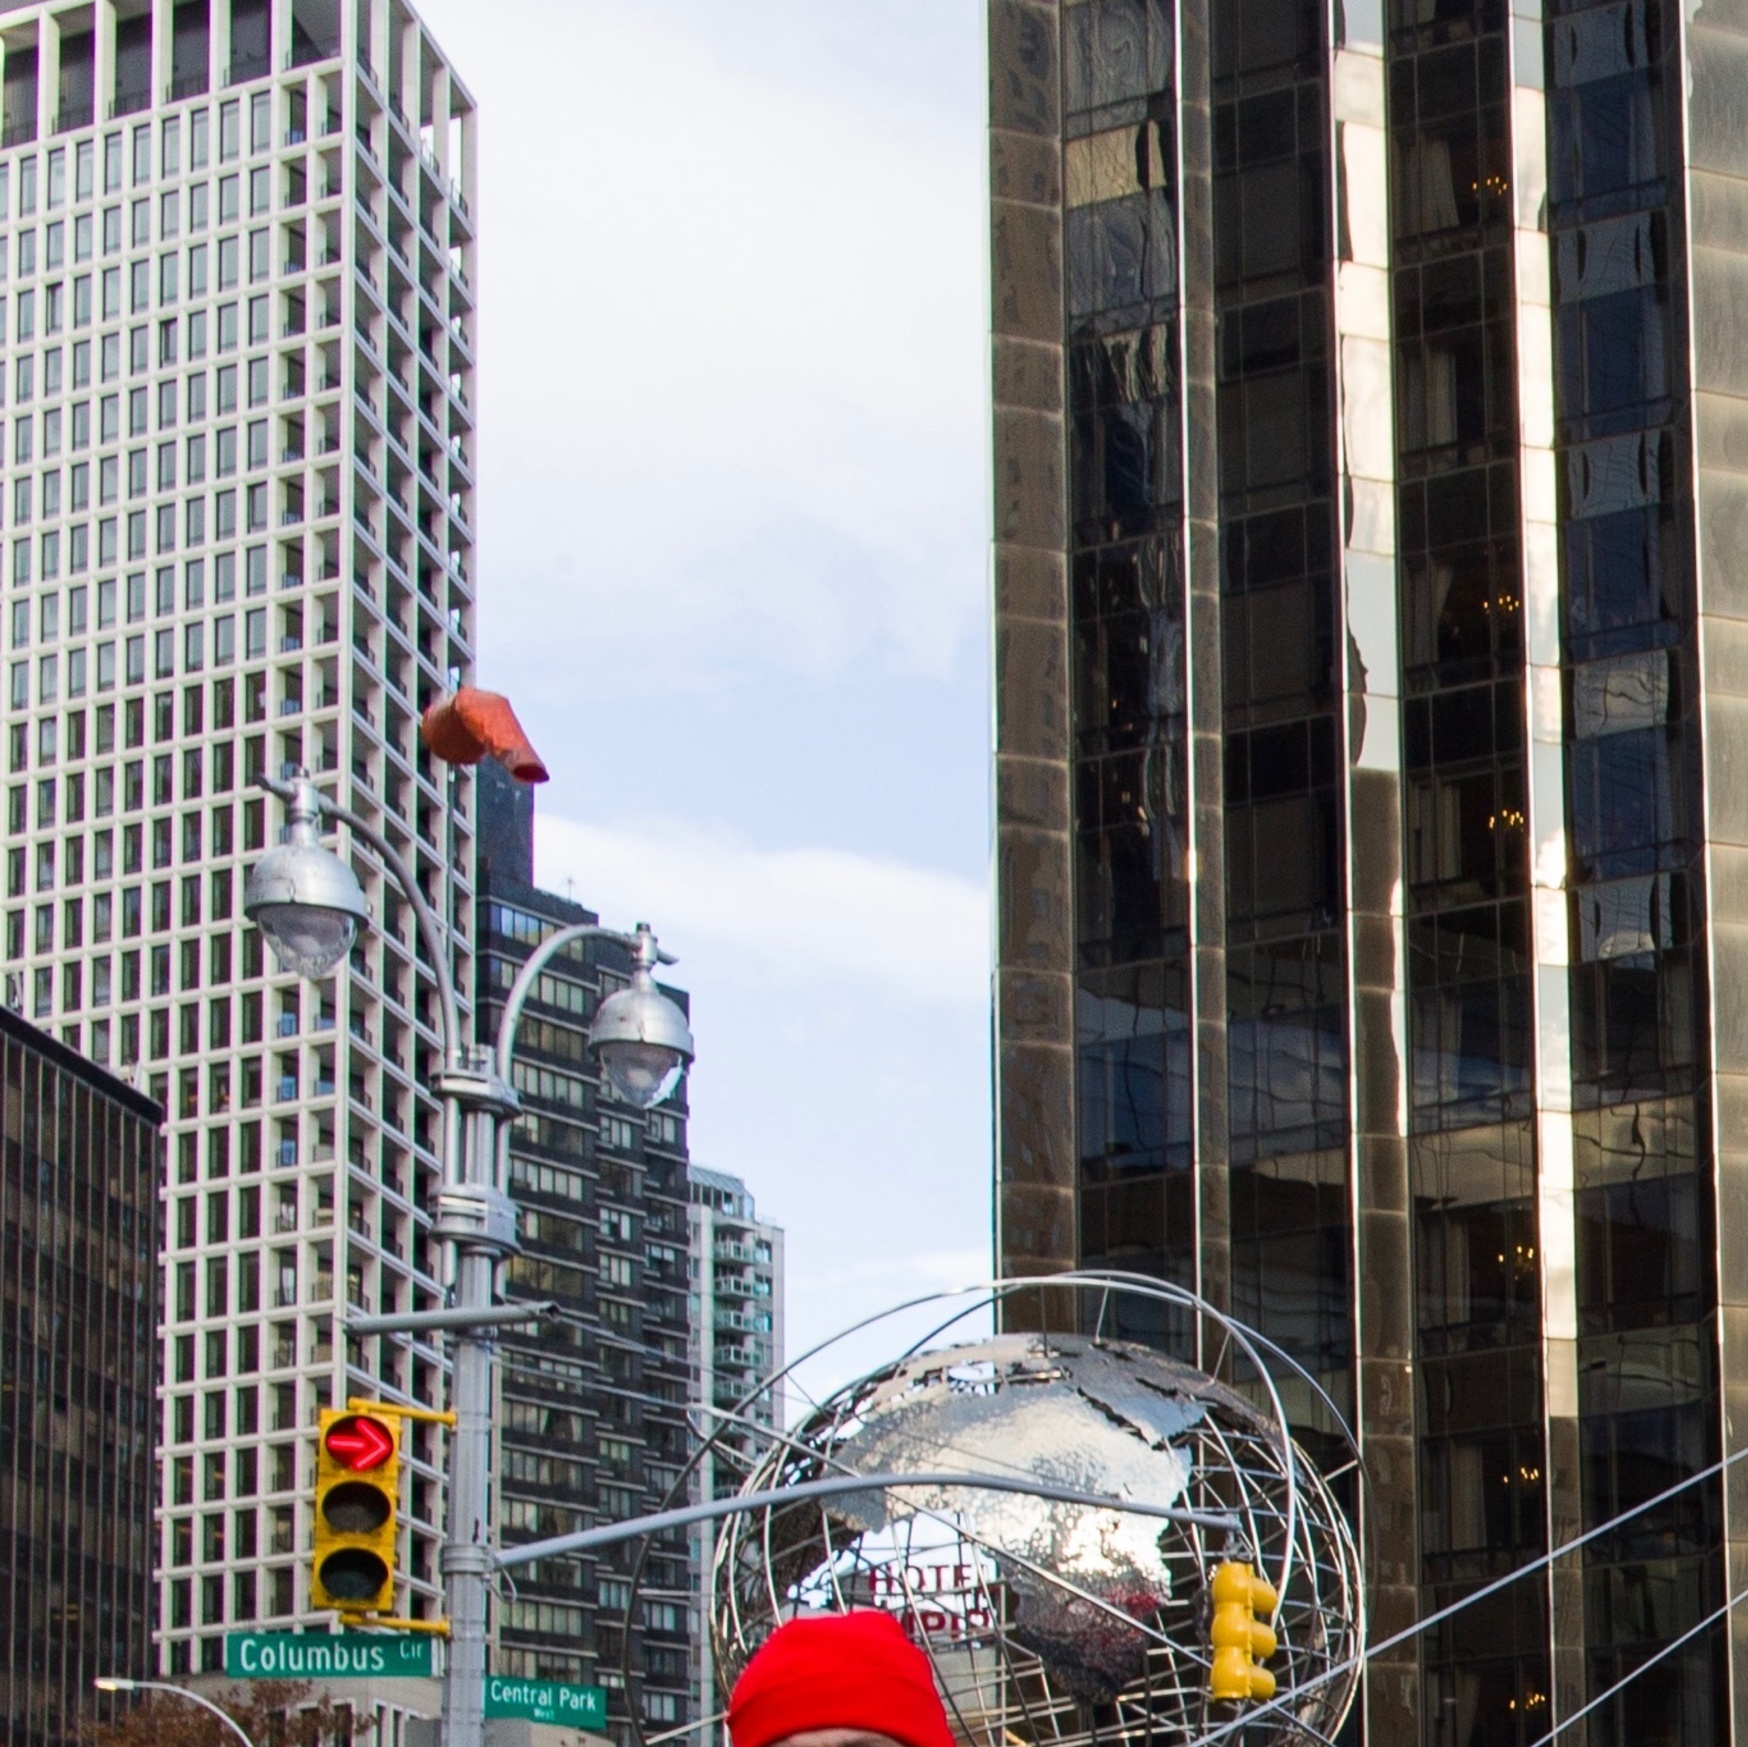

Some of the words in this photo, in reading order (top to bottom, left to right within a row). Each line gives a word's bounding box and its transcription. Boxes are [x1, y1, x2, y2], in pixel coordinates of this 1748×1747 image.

[240, 1638, 385, 1672] Columbus
[400, 1639, 424, 1660] Cir
[491, 1680, 552, 1706] Central
[559, 1687, 596, 1712] Park
